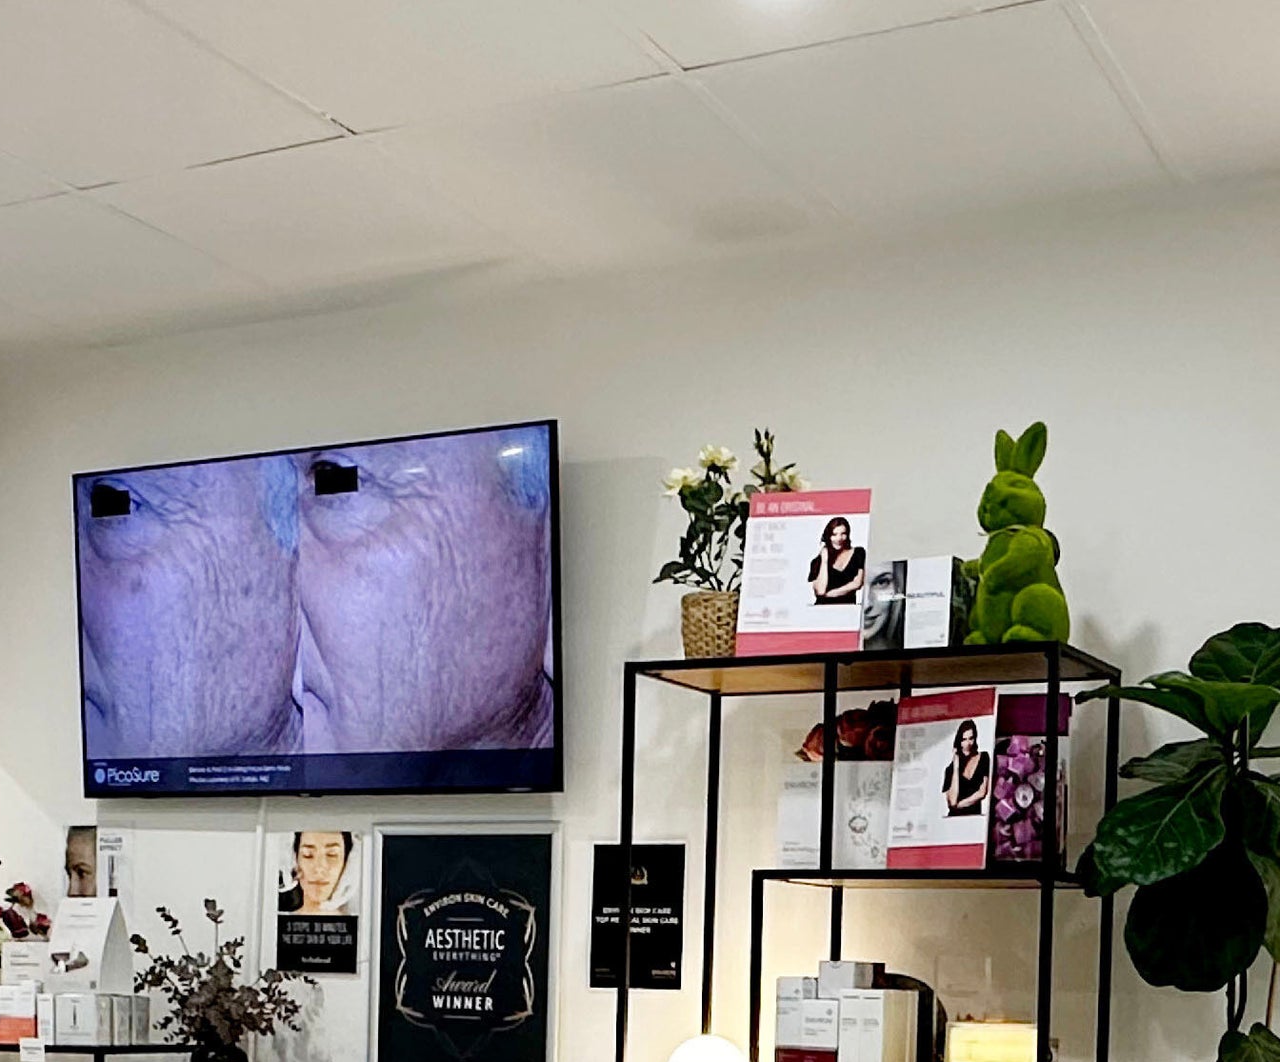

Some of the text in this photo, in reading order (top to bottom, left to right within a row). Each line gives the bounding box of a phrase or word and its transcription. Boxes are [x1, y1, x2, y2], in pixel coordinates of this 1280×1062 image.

[107, 767, 160, 784] PicoSure
[486, 897, 510, 919] CARE
[424, 928, 505, 951] AESTHETIC
[432, 995, 493, 1011] WINNER
